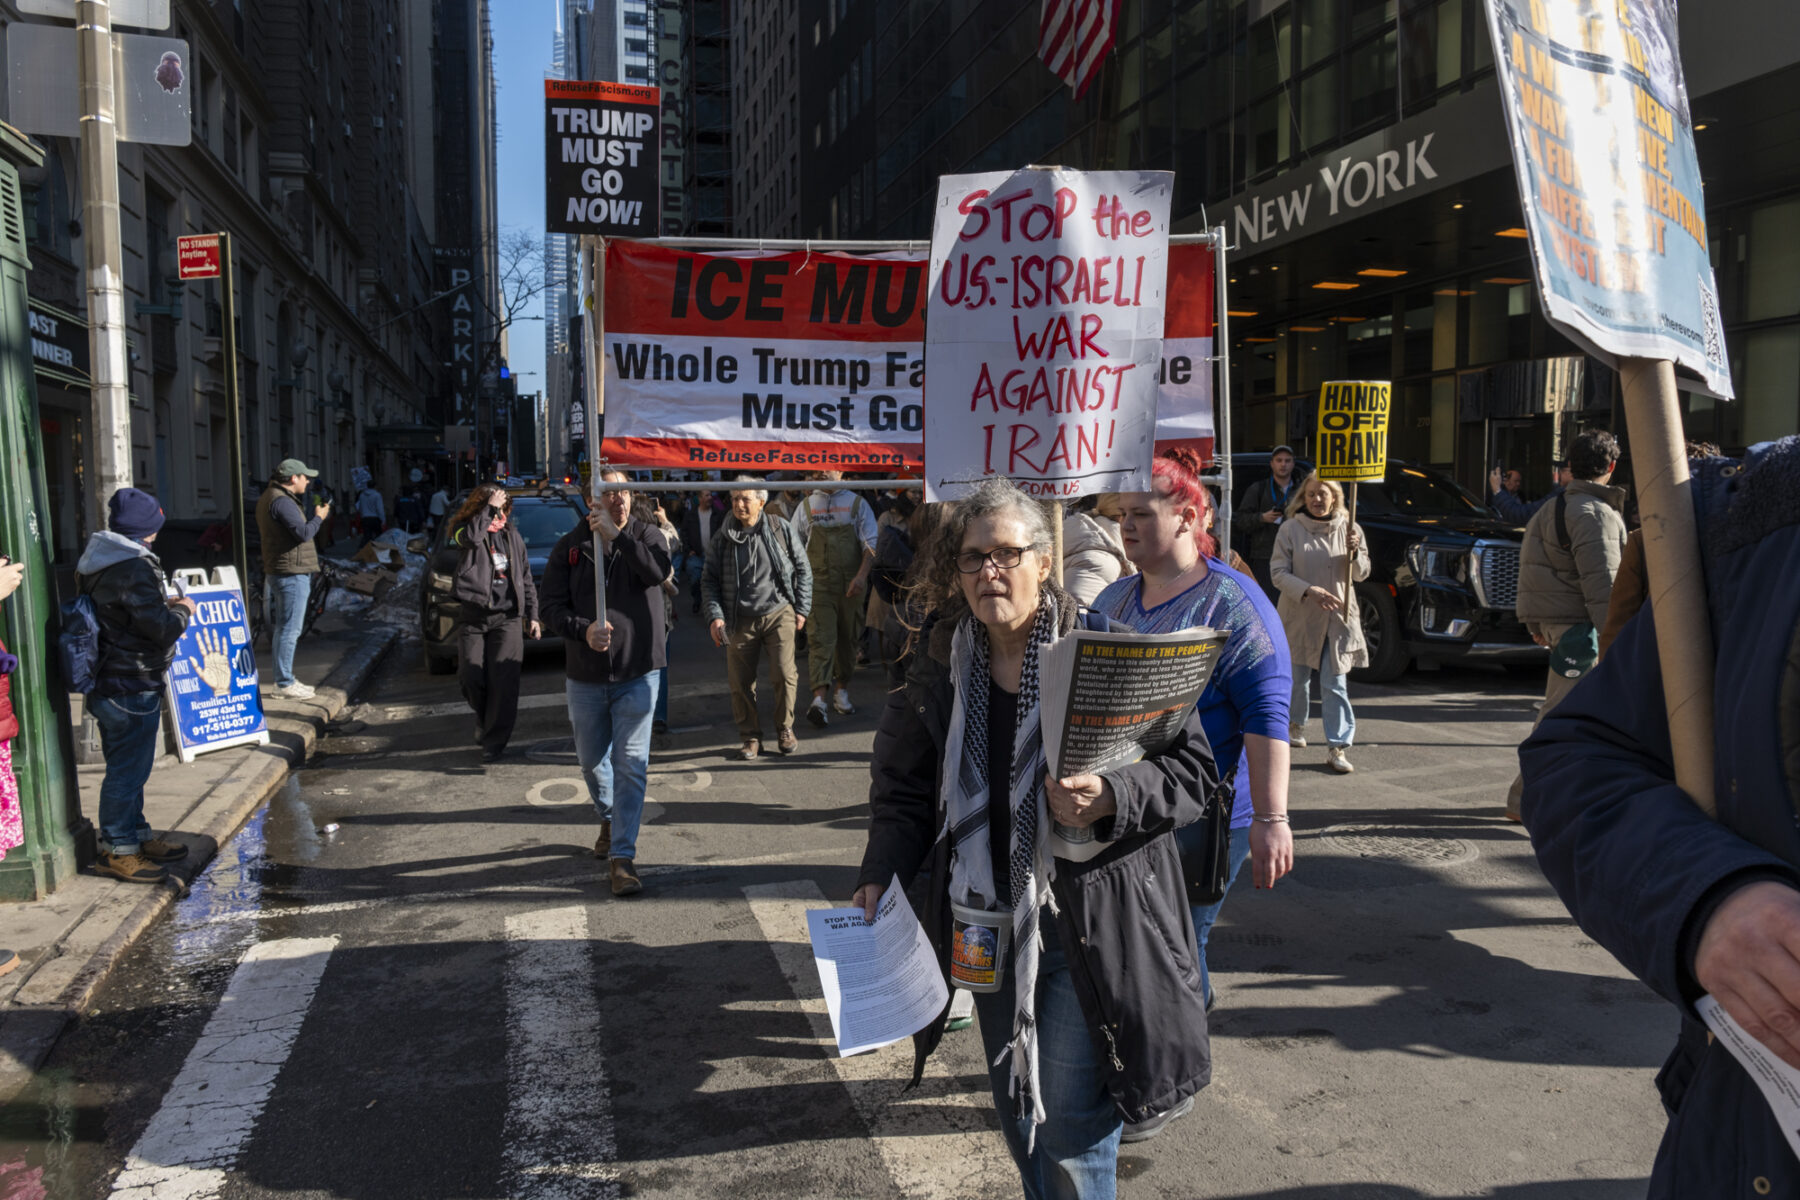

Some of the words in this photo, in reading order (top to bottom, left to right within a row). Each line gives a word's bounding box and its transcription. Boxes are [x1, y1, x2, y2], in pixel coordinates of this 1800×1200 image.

[552, 81, 651, 98] RefuseFascism.org
[1512, 32, 1527, 75] A
[1633, 83, 1674, 143] NEW
[1518, 76, 1567, 140] WAY
[551, 107, 654, 138] TRUMP
[561, 137, 643, 167] MUST
[581, 168, 624, 196] GO
[1234, 184, 1312, 250] NEW
[1320, 132, 1438, 216] YORK
[566, 197, 643, 226] NOW!
[958, 187, 1077, 242] STOP
[1092, 193, 1154, 240] the
[180, 241, 190, 249] NO
[181, 250, 207, 260] Anytime
[671, 257, 789, 322] ICE
[809, 262, 925, 327] MU
[941, 253, 1145, 310] U.S.-ISRAELI
[1013, 313, 1109, 362] WAR
[613, 342, 738, 383] Whole
[752, 347, 871, 394] Trump
[970, 362, 1136, 417] AGAINST
[1325, 385, 1388, 411] HANDS
[742, 392, 855, 430] Must
[868, 394, 924, 431] Go
[1322, 412, 1386, 431] OFF
[688, 446, 904, 467] RefuseFascism.org
[982, 419, 1116, 475] IRAN!
[1320, 431, 1384, 466] IRAN!
[1082, 645, 1094, 655] IN
[1096, 646, 1115, 656] THE
[1116, 647, 1144, 657] NAME
[1145, 648, 1158, 658] OF
[1159, 647, 1177, 657] THE
[1075, 688, 1113, 696] slaughtered
[1134, 688, 1152, 696] armed
[1076, 680, 1109, 688] brutalized
[191, 697, 227, 710] Reunities
[227, 693, 252, 704] Lovers
[220, 705, 236, 714] 43rd
[192, 715, 254, 736] 917-518-0377
[1071, 714, 1082, 725] IN
[1084, 714, 1103, 726] THE
[1104, 714, 1132, 726] NAME
[1132, 713, 1144, 724] OF
[824, 917, 845, 925] STOP
